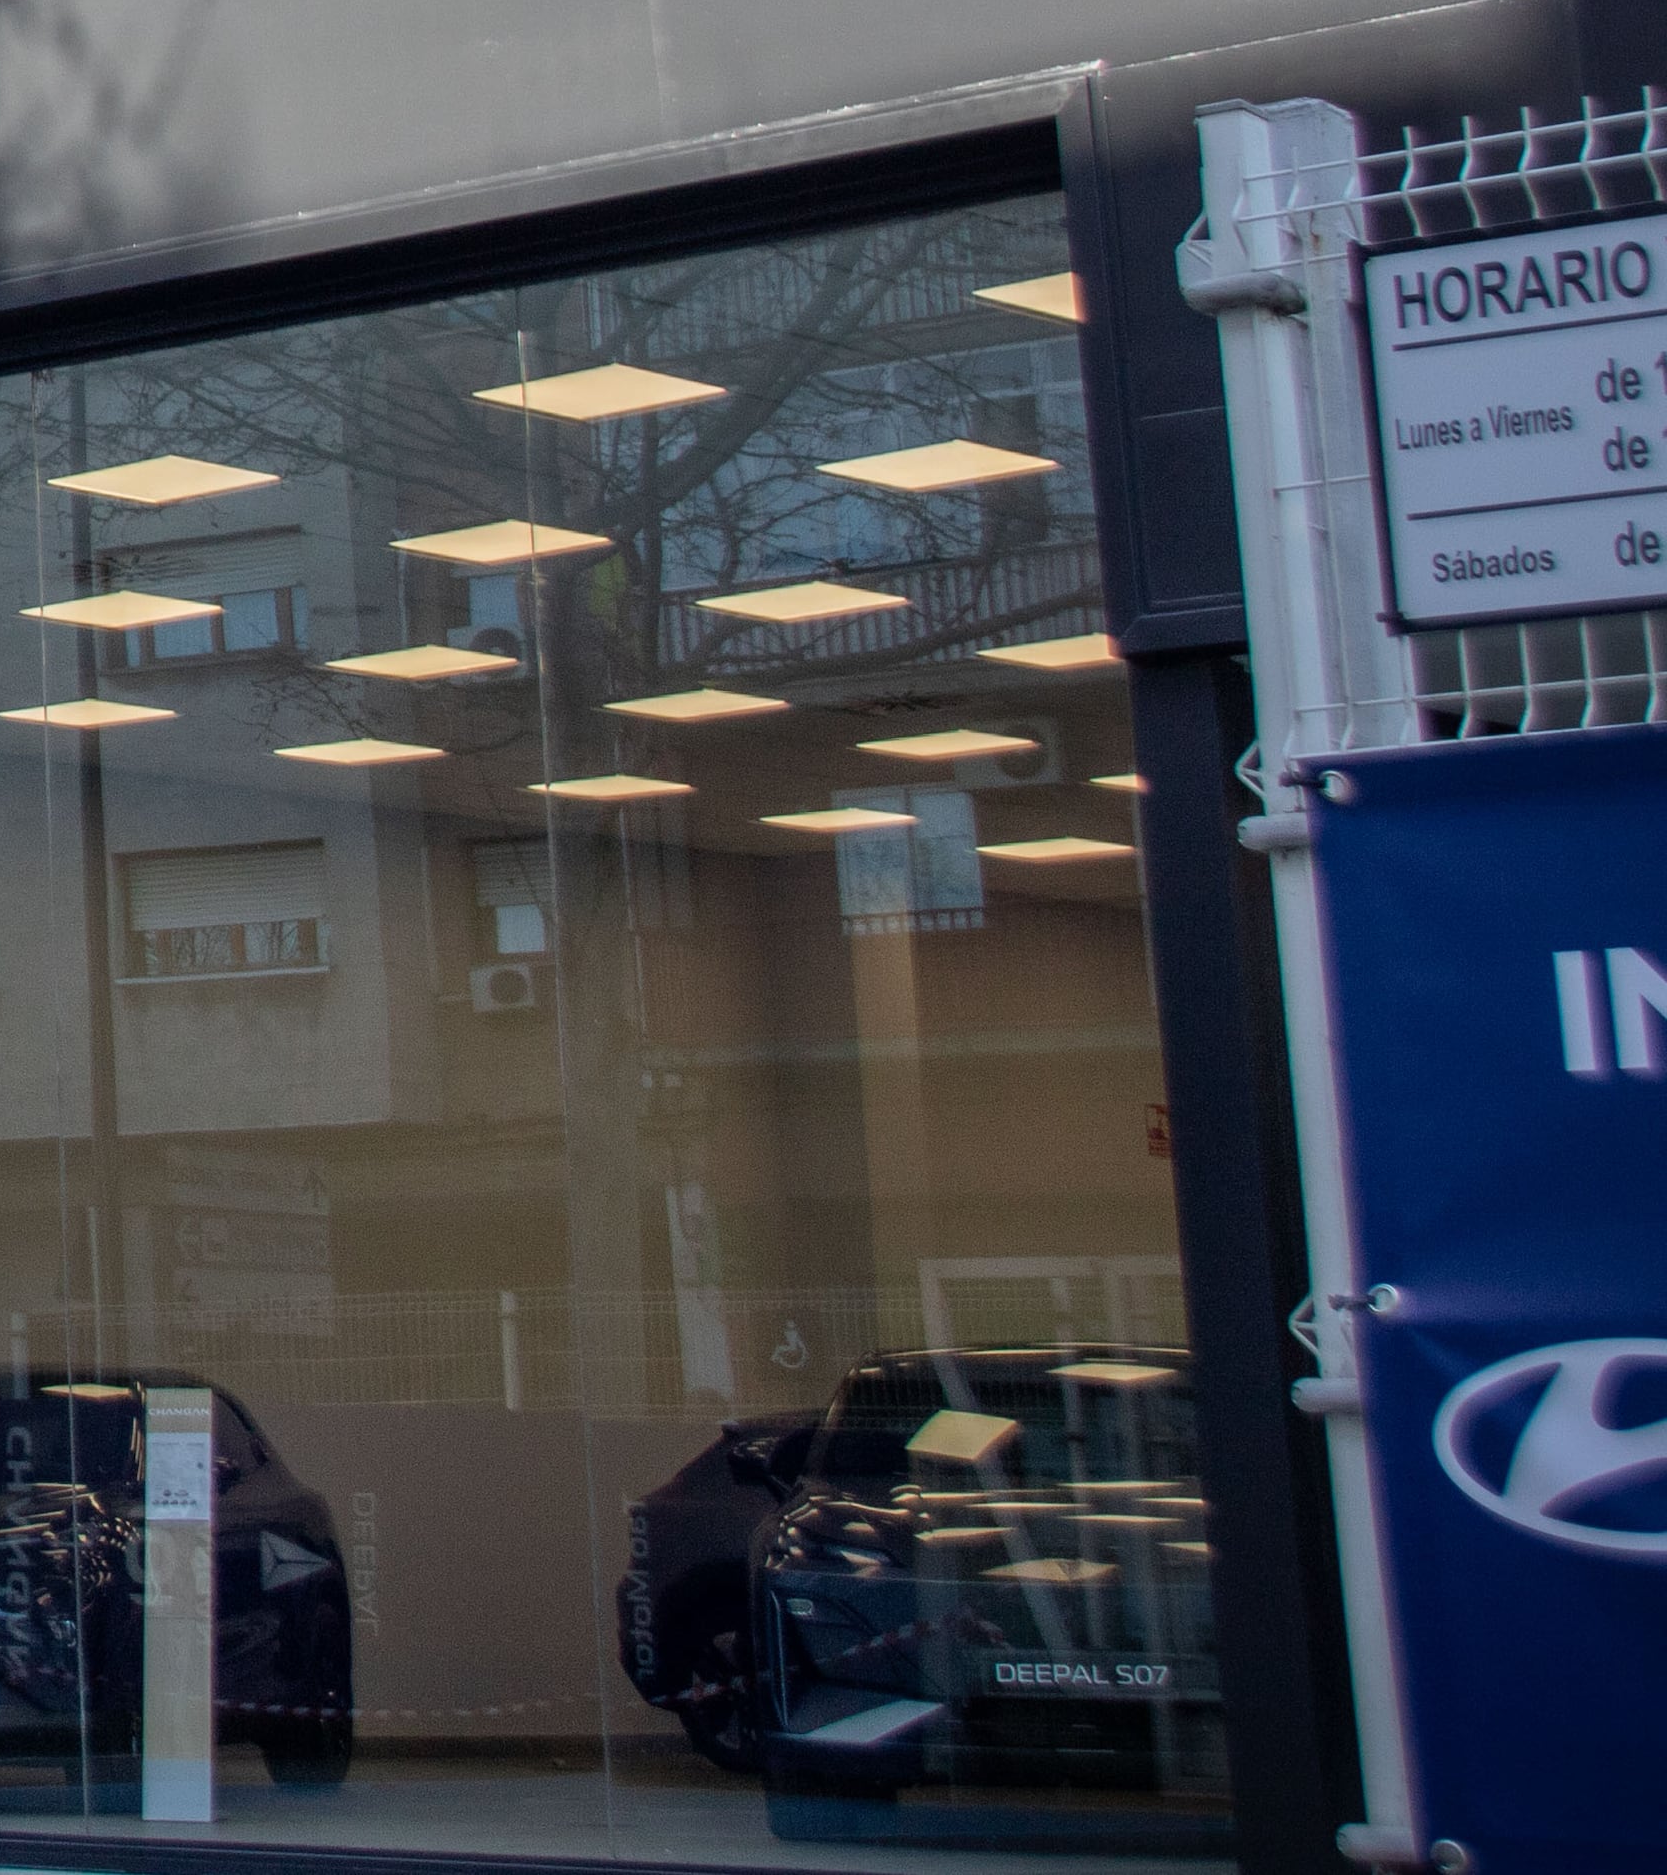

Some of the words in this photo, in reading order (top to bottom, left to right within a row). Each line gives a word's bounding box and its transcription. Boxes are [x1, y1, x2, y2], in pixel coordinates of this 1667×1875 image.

[1394, 241, 1650, 329] HORARIO
[1595, 358, 1641, 403] de
[1396, 414, 1462, 451] Lunes
[1471, 417, 1484, 442] a
[1487, 405, 1574, 438] Viernes
[1604, 426, 1649, 471] de
[1433, 545, 1555, 583] Sábados
[1614, 522, 1662, 567] de
[148, 1407, 210, 1418] CHANGAN
[995, 1662, 1110, 1686] DEEPAL
[1116, 1664, 1170, 1687] S07
